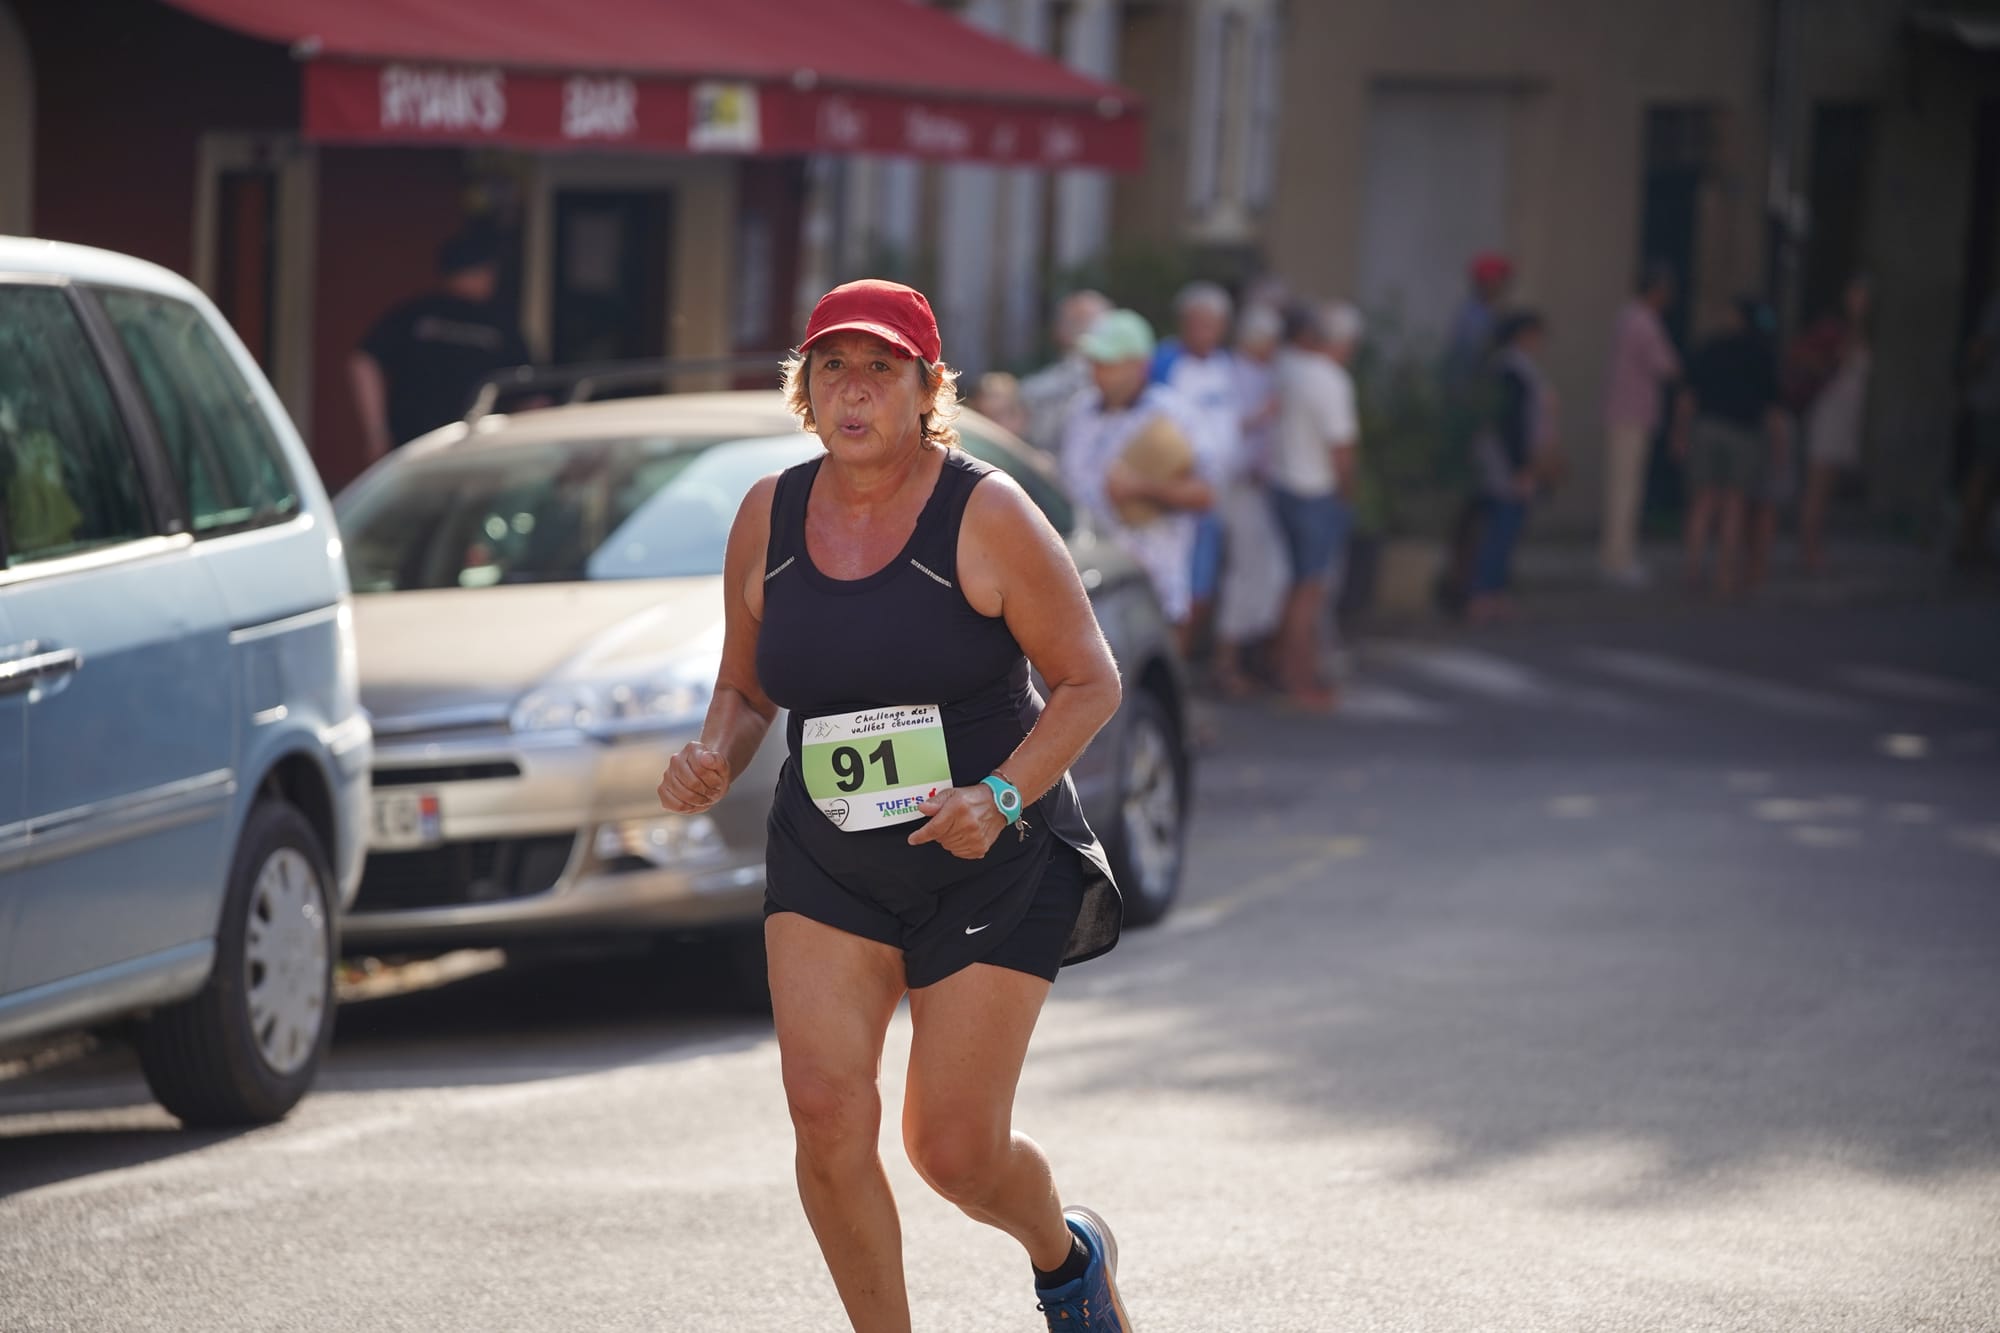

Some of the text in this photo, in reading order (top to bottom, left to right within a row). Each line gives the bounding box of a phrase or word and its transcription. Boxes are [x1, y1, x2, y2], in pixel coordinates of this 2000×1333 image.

[562, 76, 638, 138] BAR
[855, 707, 928, 724] Challenge des
[851, 716, 934, 734] vallées cévenoles
[831, 739, 899, 793] 91
[876, 795, 924, 812] TUFF'S
